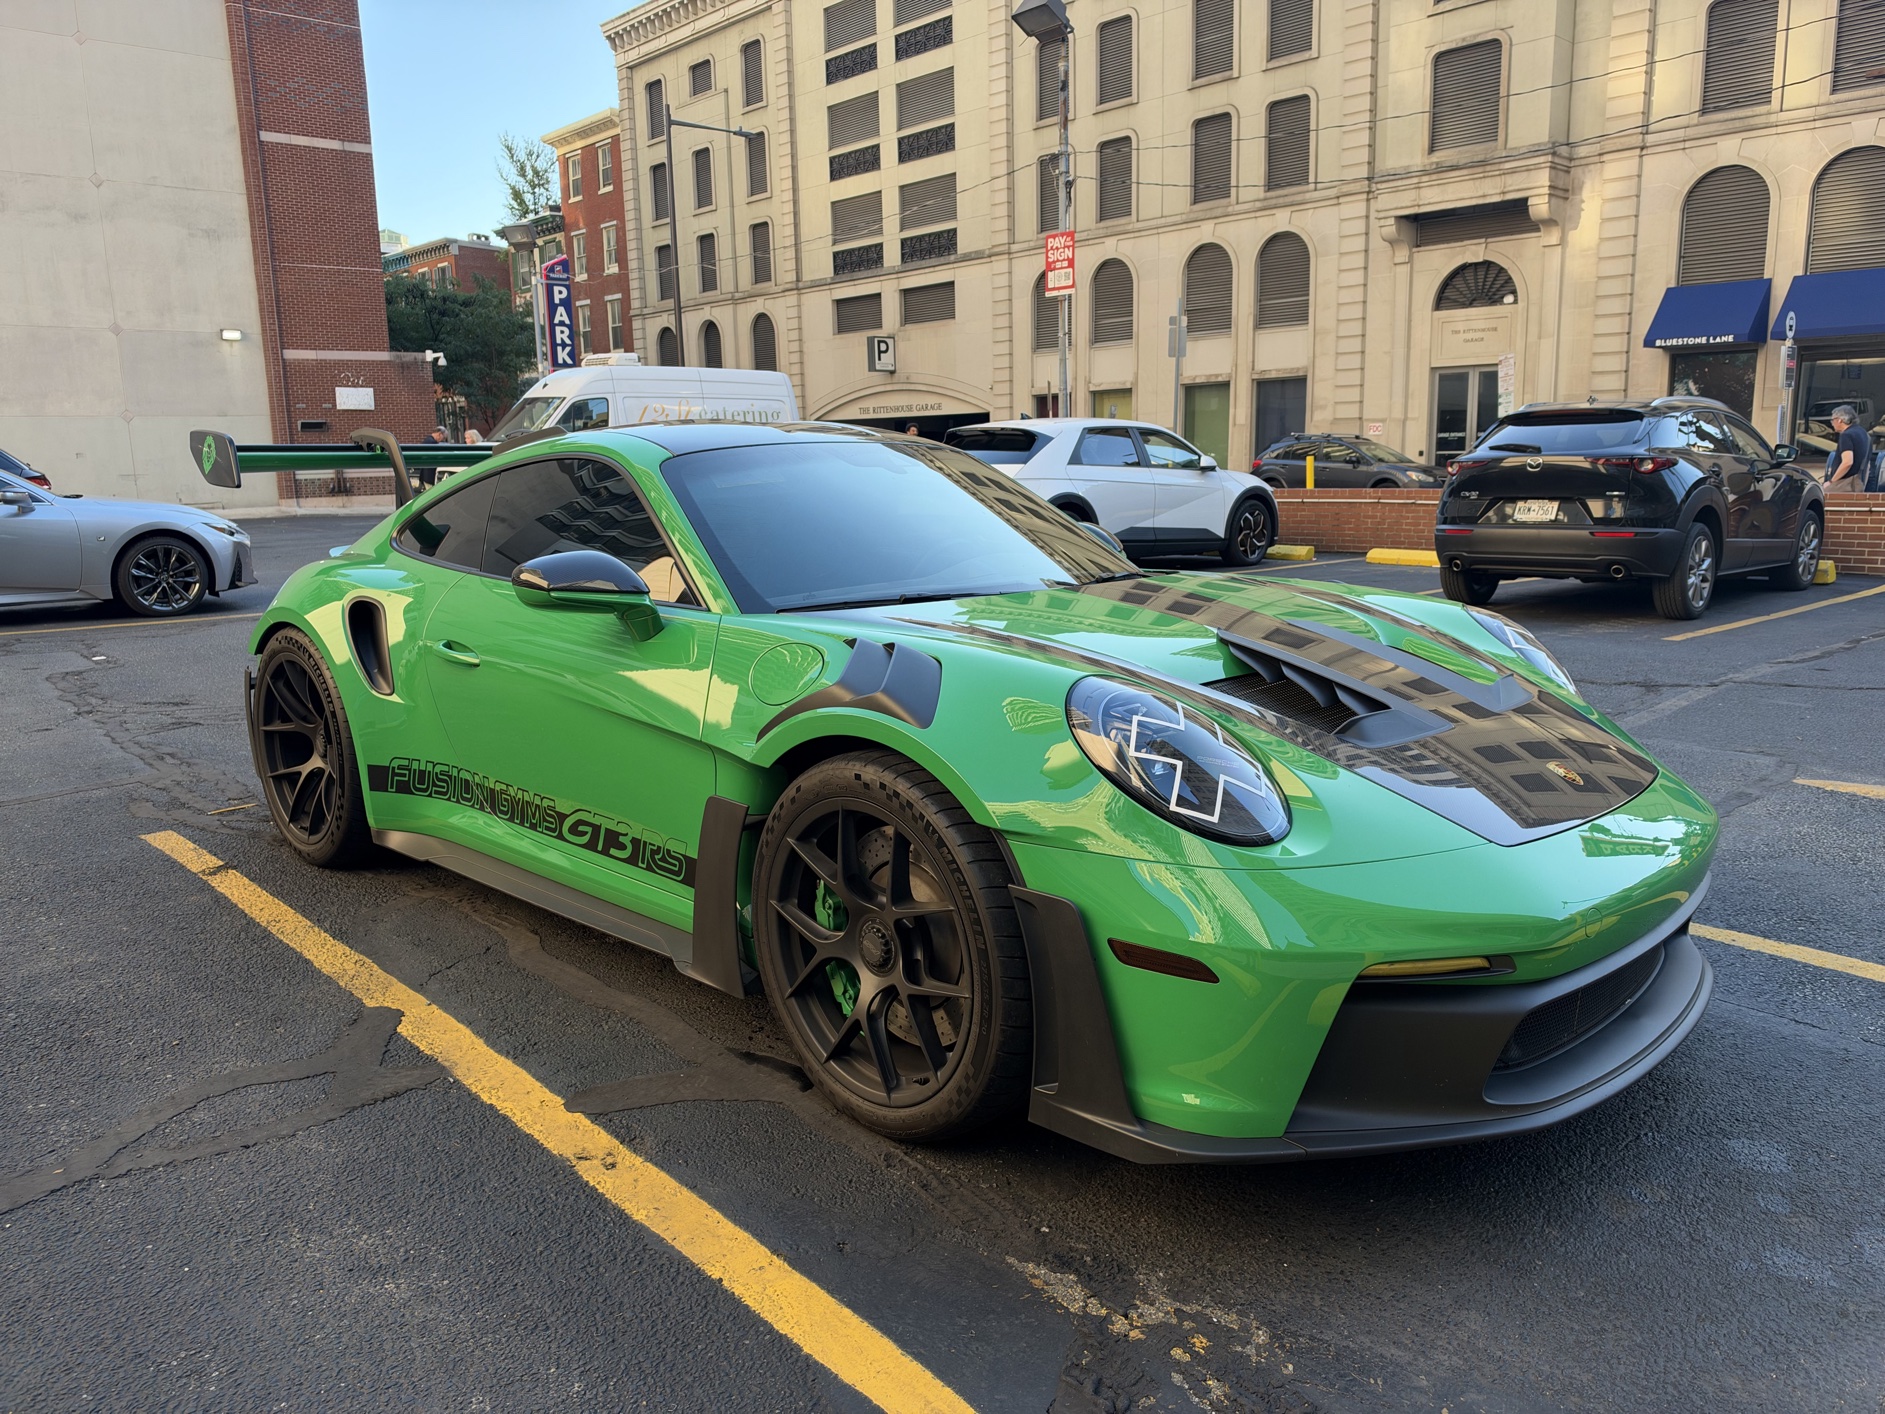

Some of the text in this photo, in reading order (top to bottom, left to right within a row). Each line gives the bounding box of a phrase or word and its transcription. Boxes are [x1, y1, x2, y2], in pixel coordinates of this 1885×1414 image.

[1047, 236, 1067, 250] PAY
[1047, 247, 1073, 262] SIGN
[553, 285, 574, 365] PARK
[1655, 334, 1735, 347] BLUESTONE LANE
[876, 339, 890, 361] P
[858, 402, 943, 415] THE RITTENHOUSE GARAGE
[1369, 424, 1382, 433] FDC
[309, 655, 334, 712] MICHELIN
[387, 756, 688, 881] FUSION GYMS GT3 RS
[940, 846, 986, 950] MICHELIN
